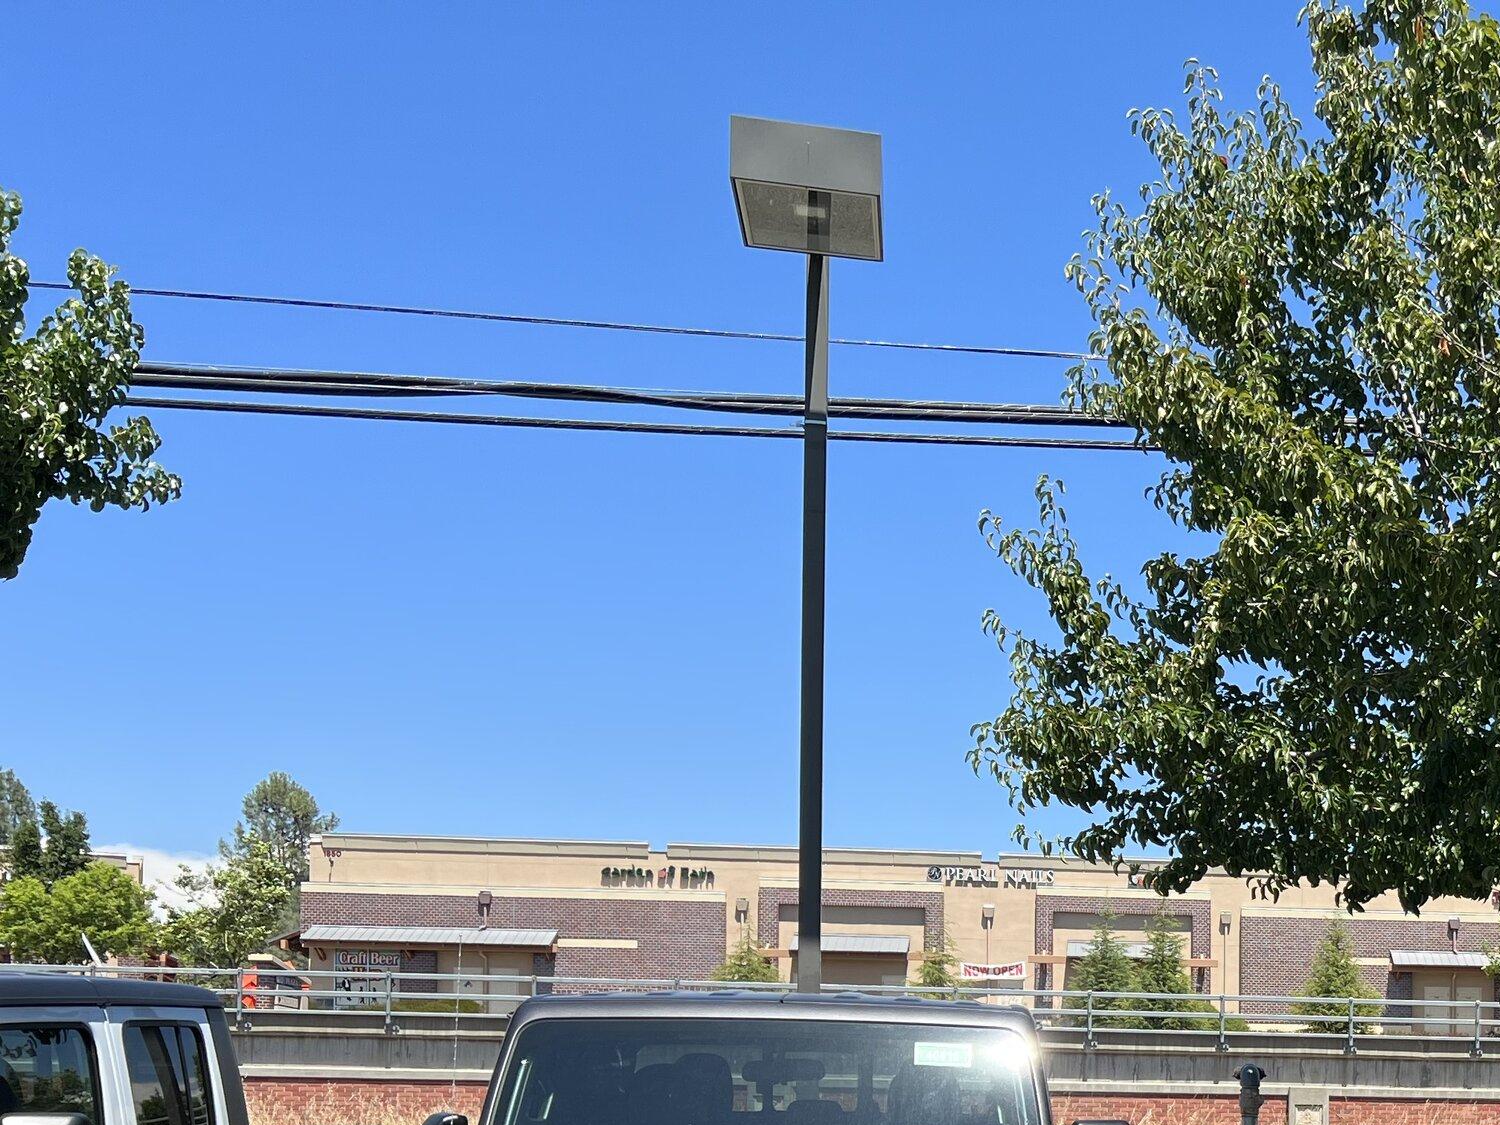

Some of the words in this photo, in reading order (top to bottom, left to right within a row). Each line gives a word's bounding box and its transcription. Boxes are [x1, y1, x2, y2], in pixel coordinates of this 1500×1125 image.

[945, 867, 998, 881] PEARL
[1005, 869, 1055, 883] NAILS
[339, 951, 367, 965] Craft
[371, 952, 399, 965] Beer
[963, 964, 989, 977] NOW
[993, 963, 1023, 976] OPEN
